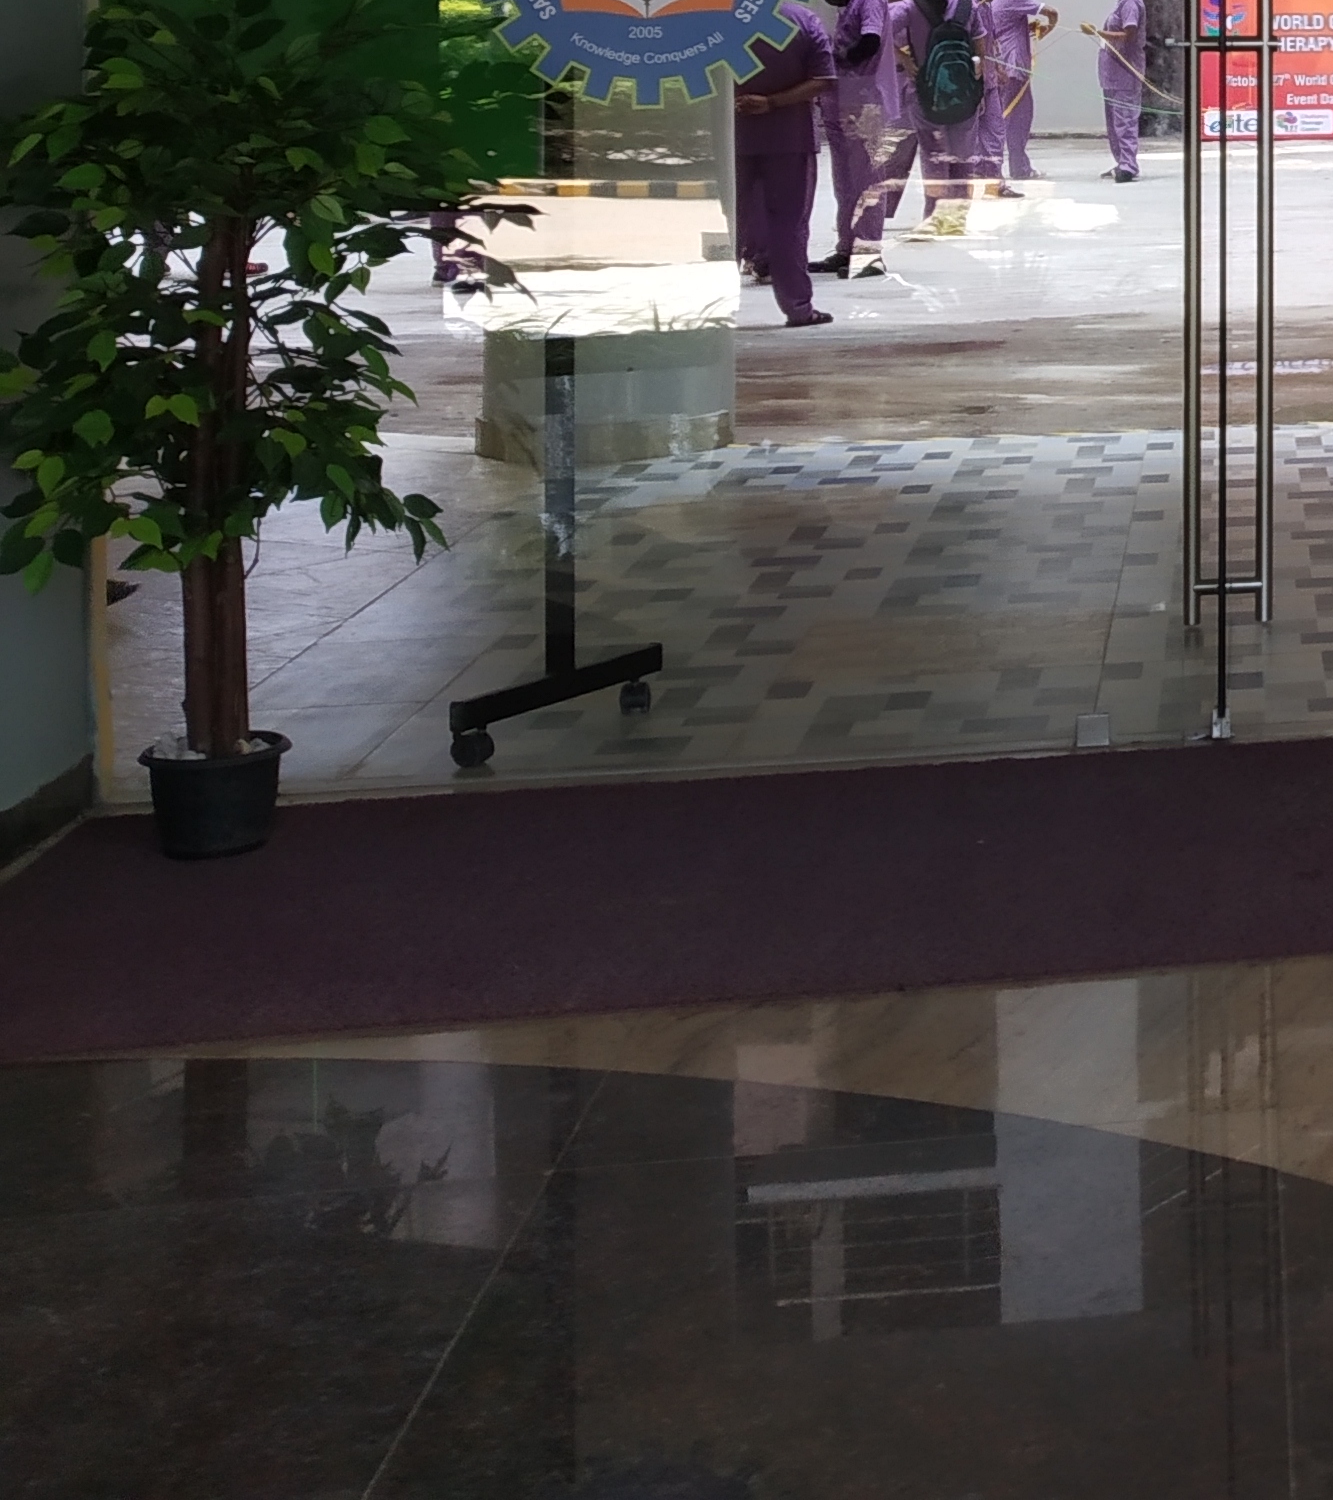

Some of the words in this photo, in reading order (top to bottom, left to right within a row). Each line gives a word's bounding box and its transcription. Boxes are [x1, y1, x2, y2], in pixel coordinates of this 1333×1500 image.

[628, 26, 663, 39] 2005
[570, 32, 641, 65] Knowledge
[644, 38, 707, 64] Conquers
[706, 31, 724, 46] All
[1294, 74, 1327, 86] World
[1287, 93, 1317, 105] Event
